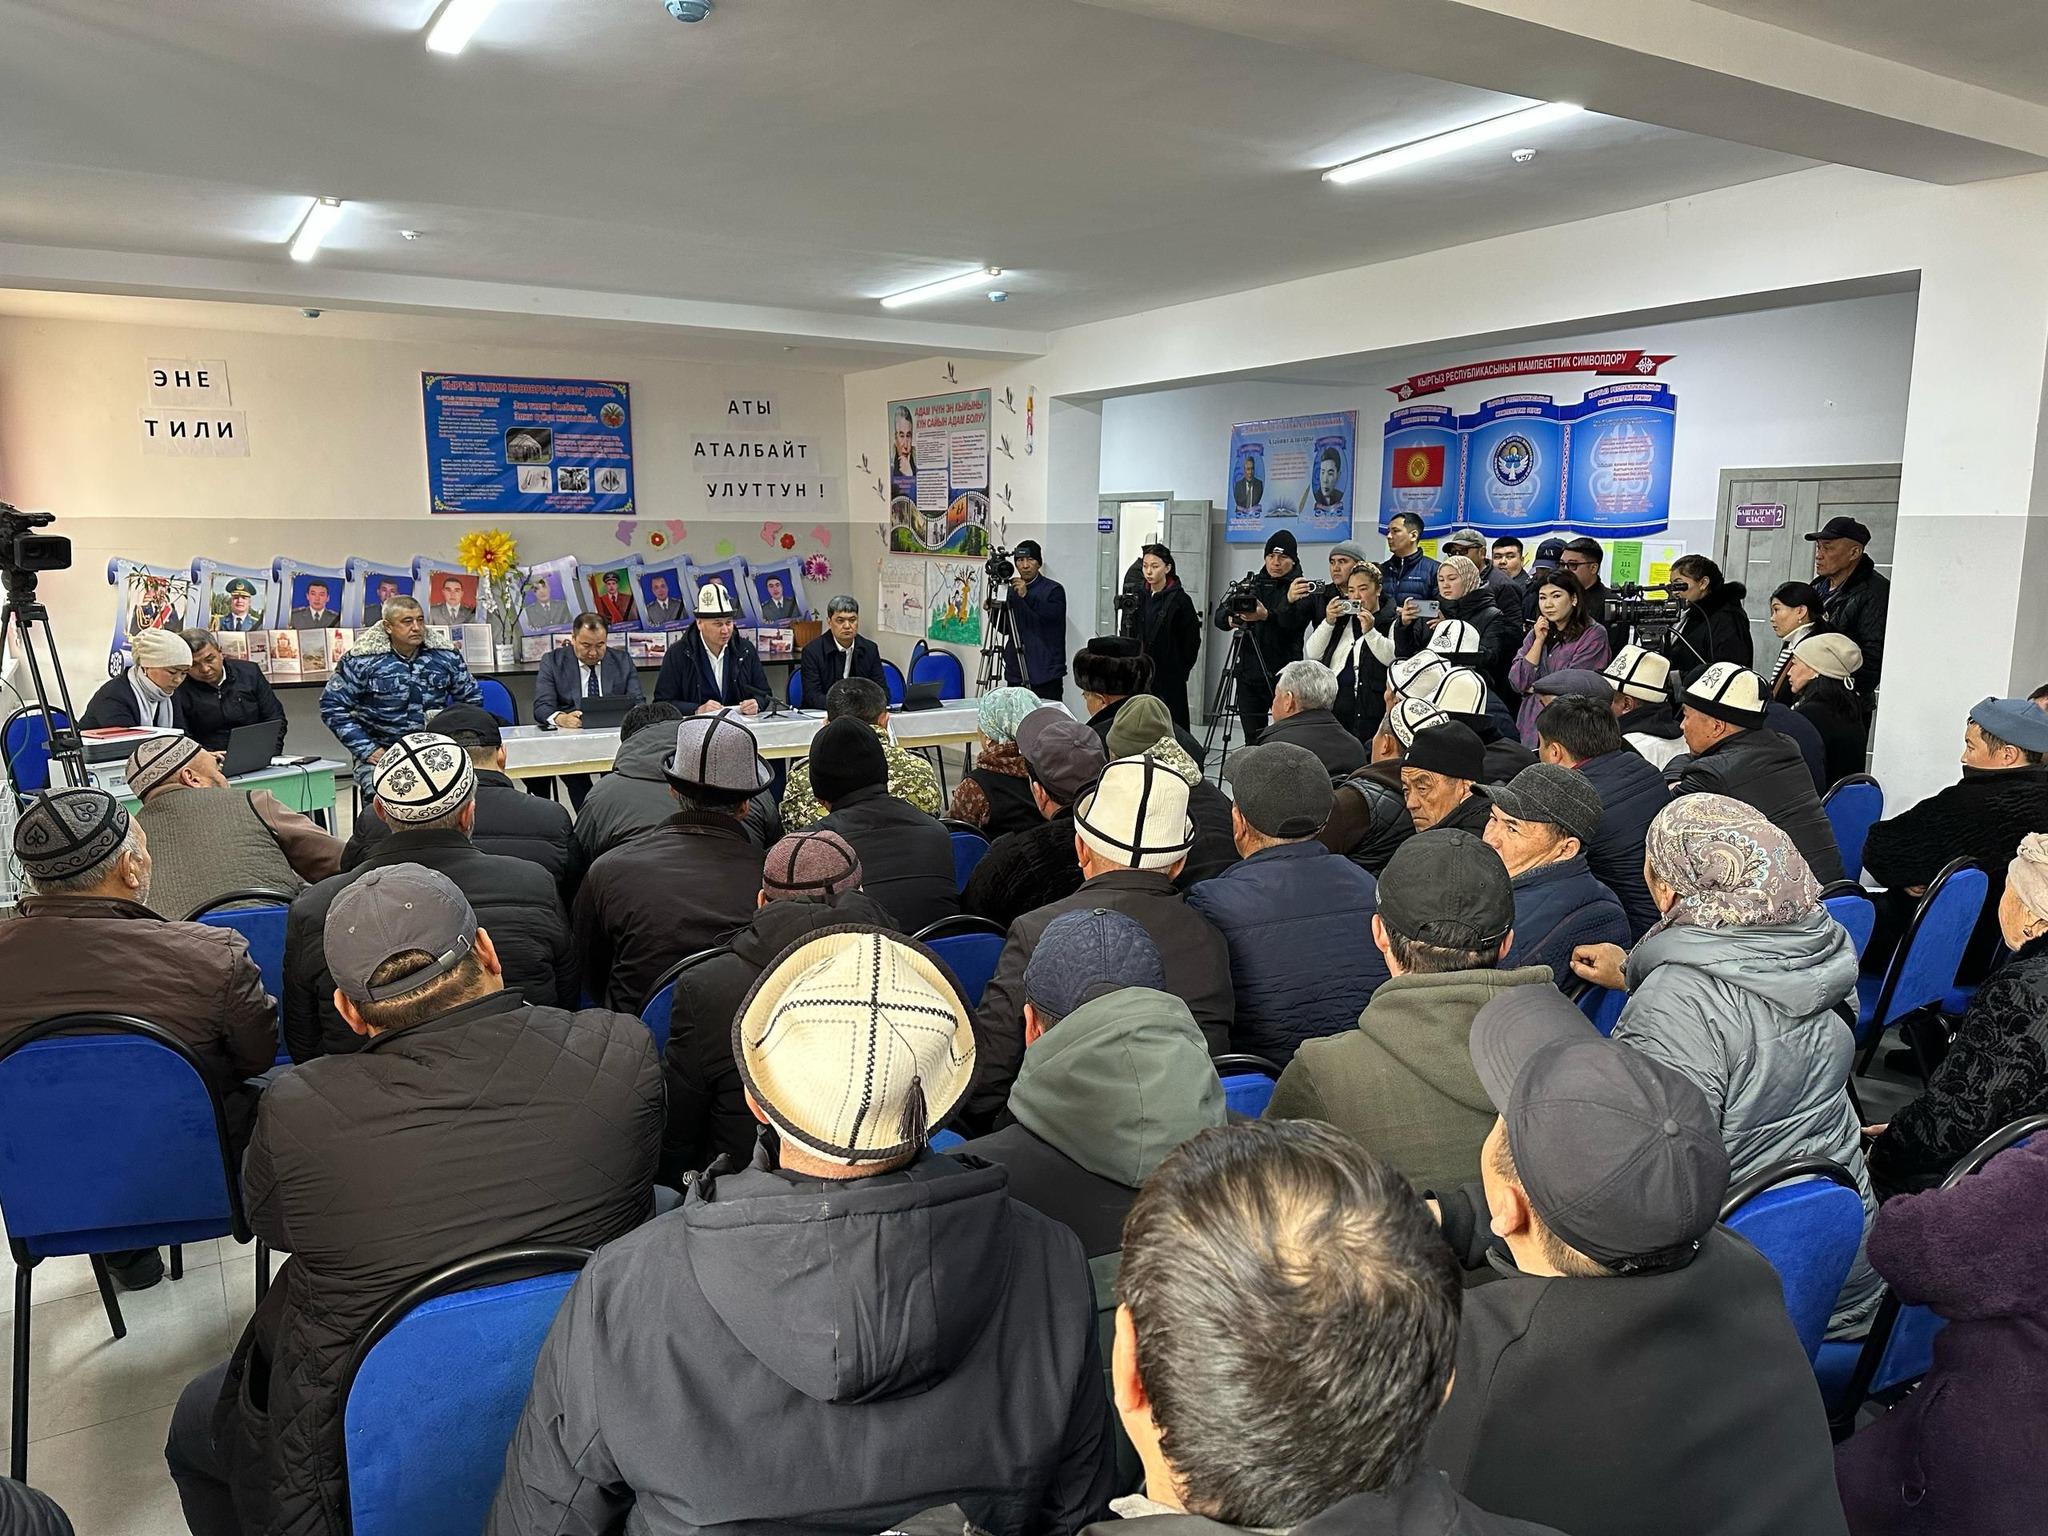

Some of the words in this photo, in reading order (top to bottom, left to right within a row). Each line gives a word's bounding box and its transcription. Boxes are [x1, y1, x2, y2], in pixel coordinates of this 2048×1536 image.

[153, 370, 210, 388] ЭНЕ
[1417, 374, 1445, 387] КЫРГЫЗ
[1445, 361, 1516, 382] РЕСПУБЛИКАСЫНЫН
[1517, 357, 1571, 372] МАМЛЕКЕТТИК
[1572, 353, 1628, 367] СИМВОЛДОРУ
[728, 400, 771, 415] АТЫ
[144, 419, 233, 438] ТИЛИ
[694, 440, 807, 458] АТАЛБАЙТ
[707, 483, 806, 498] УЛУТТУН
[1775, 509, 1782, 522] 2
